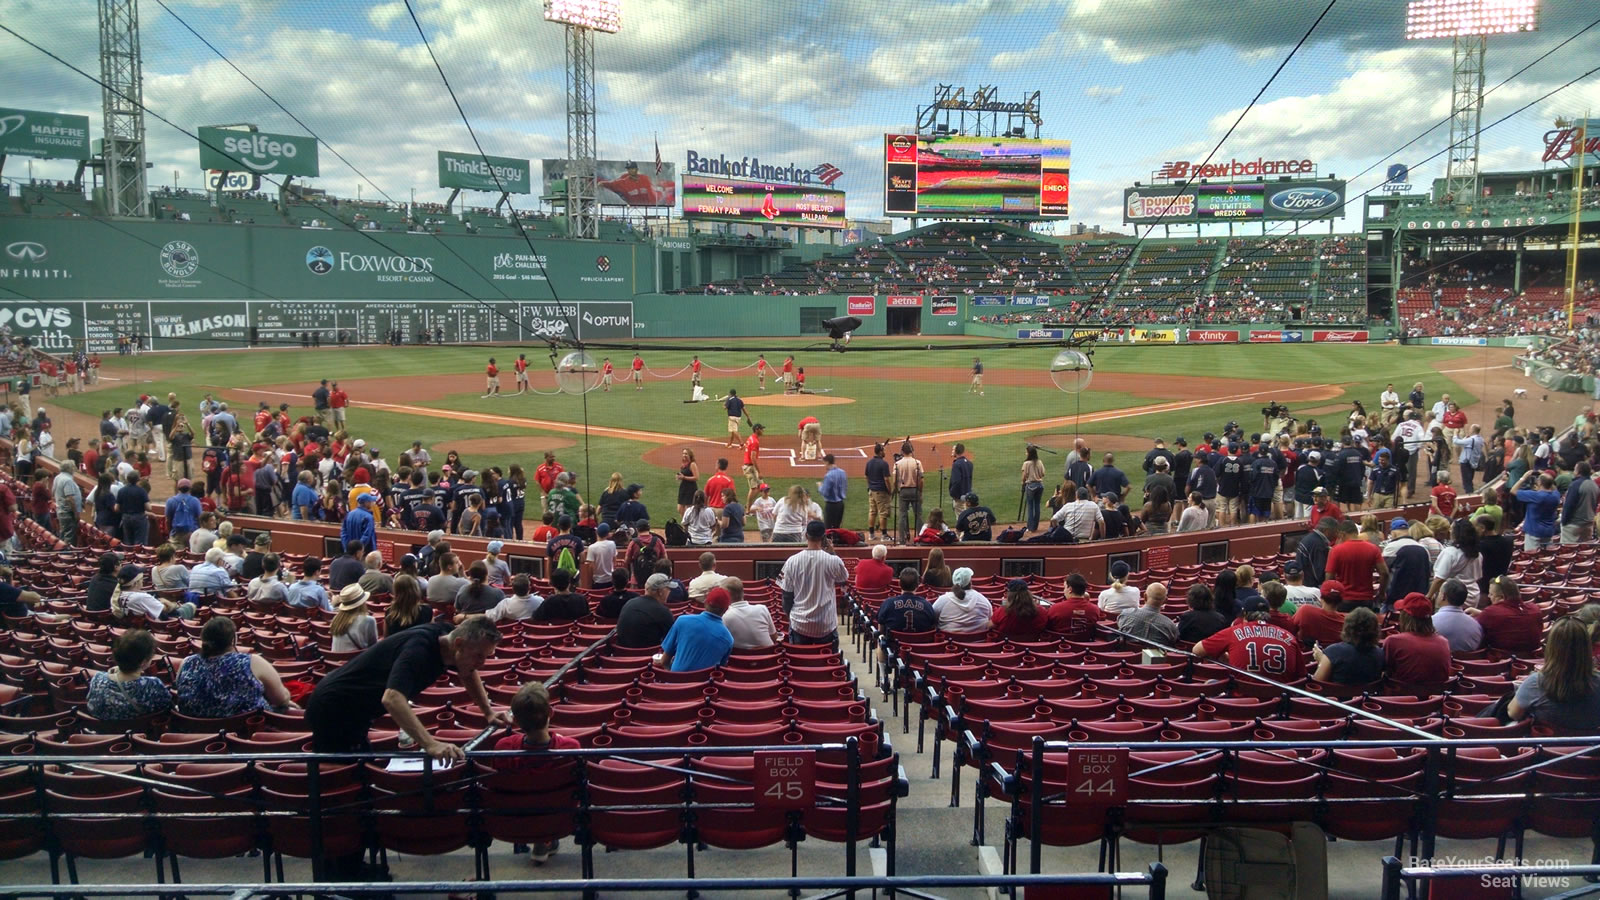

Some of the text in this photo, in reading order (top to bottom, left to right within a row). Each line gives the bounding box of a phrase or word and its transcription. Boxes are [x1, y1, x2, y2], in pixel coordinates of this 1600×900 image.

[918, 83, 1043, 129] John Hancock
[31, 125, 85, 137] MAPFRE
[35, 136, 82, 147] INSURANCE
[224, 134, 297, 159] selfeo
[445, 157, 522, 182] ThinkEnergy
[687, 150, 811, 184] Bank of America
[1192, 162, 1230, 177] new
[1231, 158, 1312, 177] balance
[705, 184, 734, 194] WELCOME
[1044, 184, 1066, 192] ENEOS
[1282, 191, 1325, 208] Ford
[698, 205, 740, 215] FENWAY PARK
[796, 203, 834, 213] MOST BELOVED
[1146, 205, 1191, 215] DONUTS
[801, 214, 828, 222] BALLPARK
[162, 242, 191, 258] RED SOX
[662, 240, 691, 249] ABIOMED
[515, 254, 547, 262] PAN-MASS
[892, 297, 917, 305] aetna
[1016, 296, 1034, 304] NESN
[544, 306, 577, 317] WEBB
[15, 307, 72, 328] CVS
[594, 316, 630, 326] OPTUM
[1029, 329, 1053, 339] jetBlue
[1199, 331, 1228, 341] xfinity
[548, 501, 564, 515] 34
[894, 599, 924, 611] DAD
[903, 610, 916, 632] 1
[1233, 625, 1294, 646] RAMIREZ
[1246, 641, 1287, 675] 13
[765, 757, 804, 767] FIELD
[1078, 754, 1117, 764] FIELD
[770, 767, 798, 777] BOX
[1083, 764, 1111, 775] BOX
[764, 781, 803, 800] 45
[1076, 779, 1116, 796] 44
